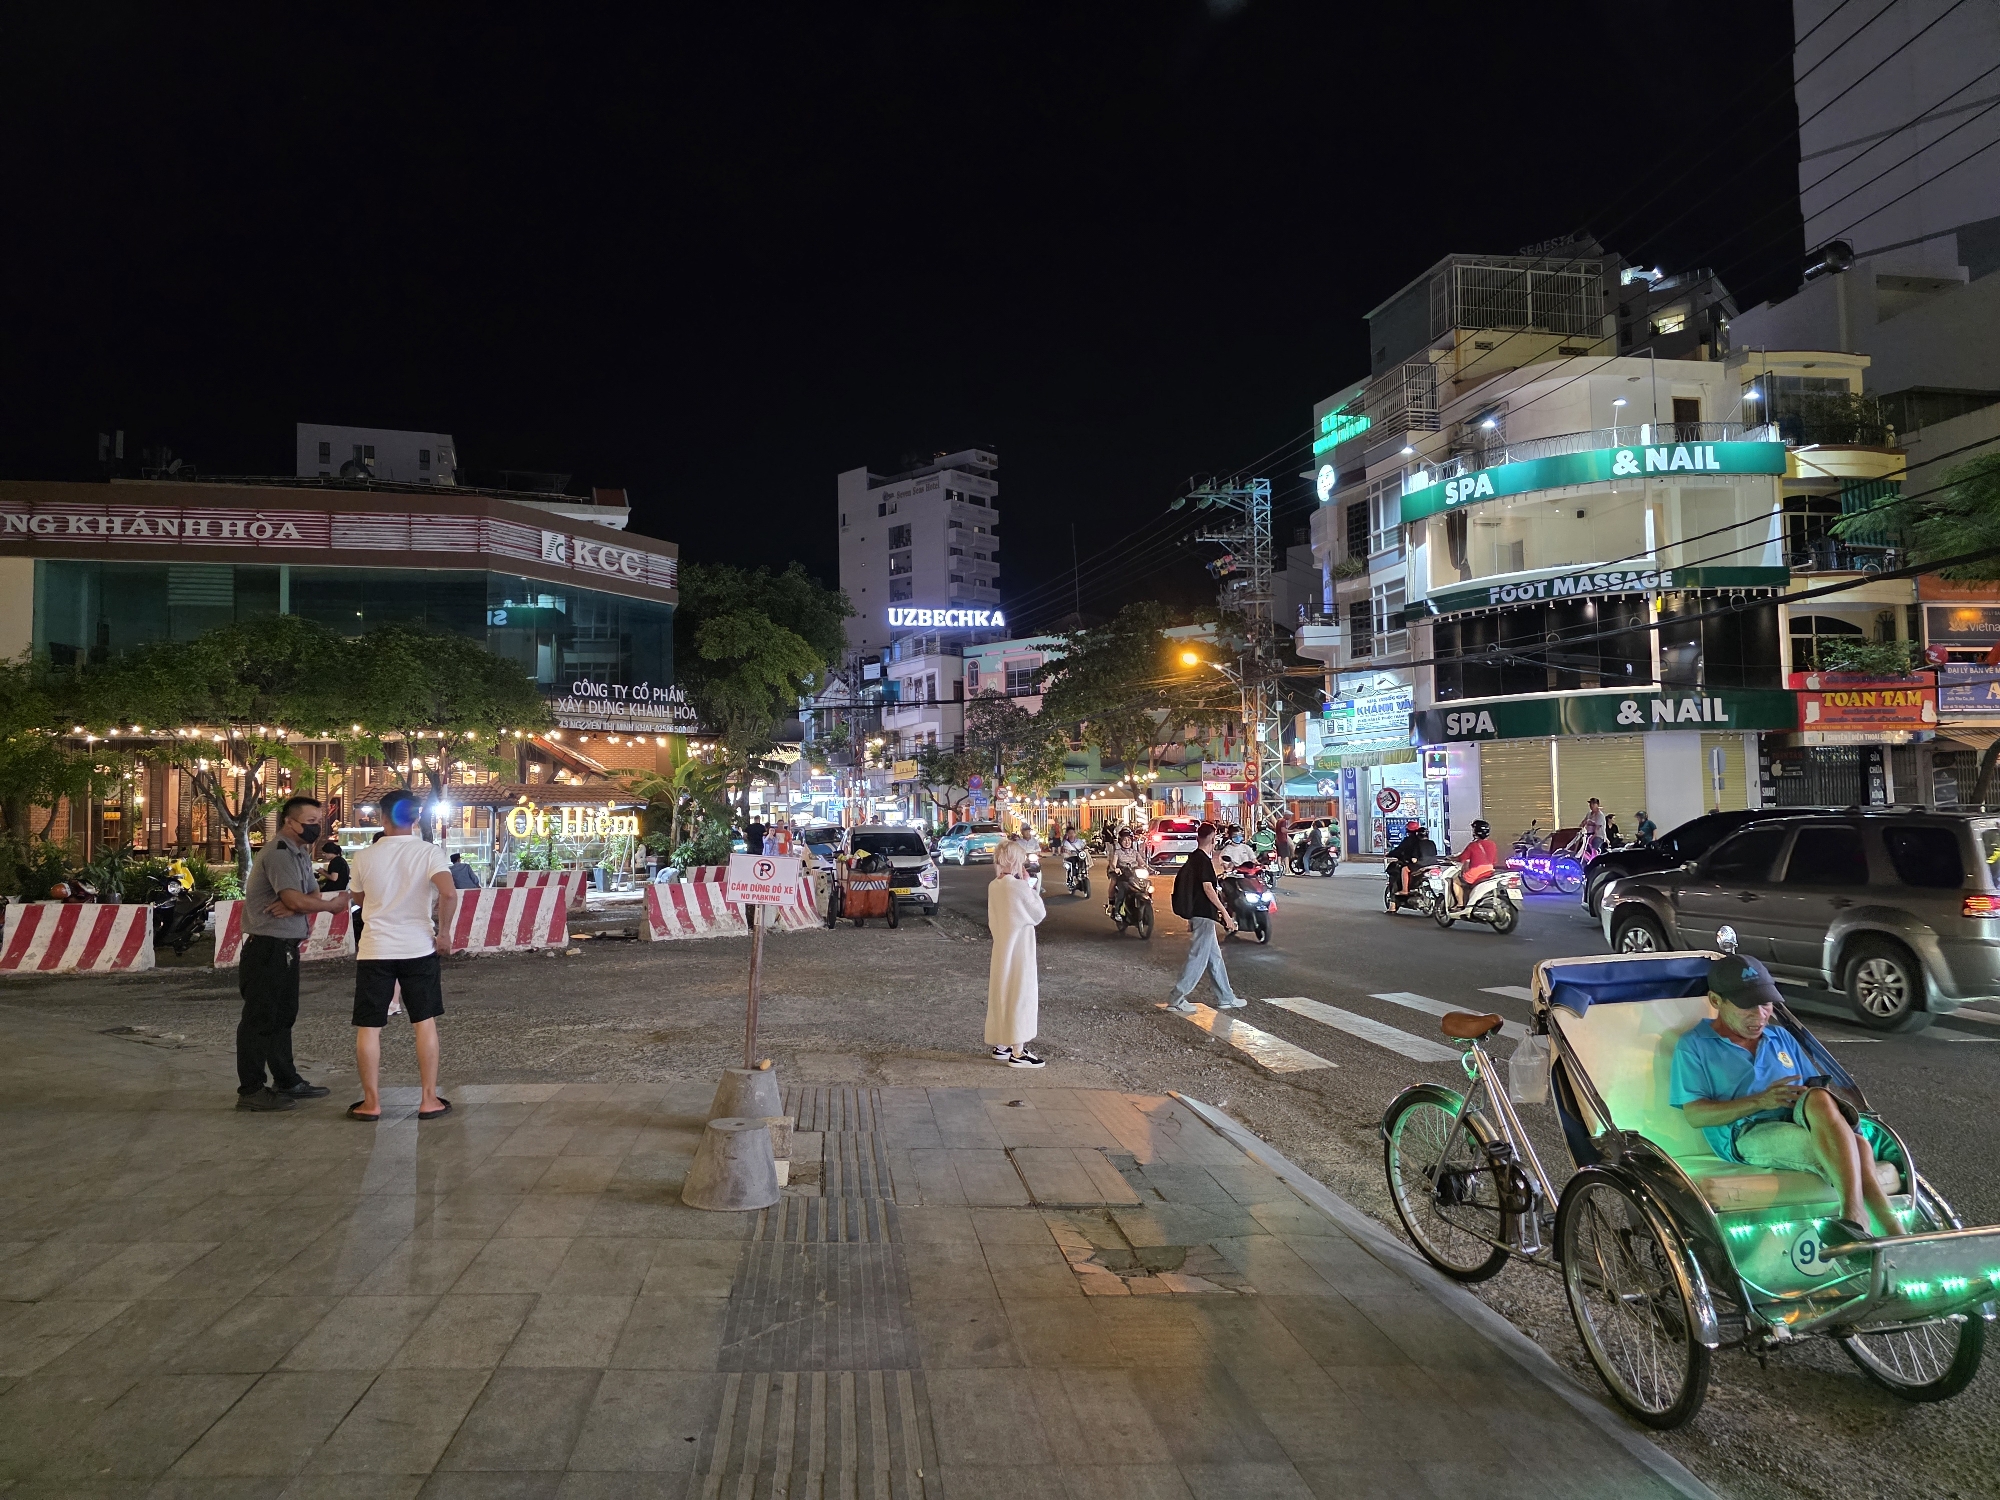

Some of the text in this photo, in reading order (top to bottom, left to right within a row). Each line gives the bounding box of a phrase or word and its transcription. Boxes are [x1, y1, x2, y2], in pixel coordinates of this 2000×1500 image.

[1519, 233, 1575, 256] SEAESTA
[1612, 446, 1720, 476] & NAIL
[896, 489, 912, 499] Seven
[912, 486, 924, 496] Seas
[925, 482, 940, 492] Hotel
[1445, 472, 1494, 505] SPA
[0, 510, 303, 540] NG KHÁNH HÒA
[571, 538, 641, 577] KCC
[1489, 571, 1673, 604] FOOT MASSAGE
[887, 607, 1005, 627] UZBECHKA
[1960, 665, 1968, 673] LÝ
[572, 678, 684, 703] CÔNG TY CỔ PHẦN
[558, 695, 698, 720] XÂY DỰNG KHÁNH HÒA
[1356, 702, 1394, 715] KHÁNH
[1616, 697, 1728, 725] & NAIL
[559, 719, 569, 729] 43
[616, 721, 634, 731] MINH
[1446, 710, 1495, 736] SPA
[1864, 732, 1879, 741] THOẠI
[1212, 766, 1225, 775] TÂN
[1762, 786, 1776, 797] SMART
[506, 795, 639, 838] Ớt Hiểm
[759, 863, 771, 877] P
[731, 880, 748, 891] CẤM
[784, 885, 793, 894] XE
[752, 893, 780, 902] PARKING
